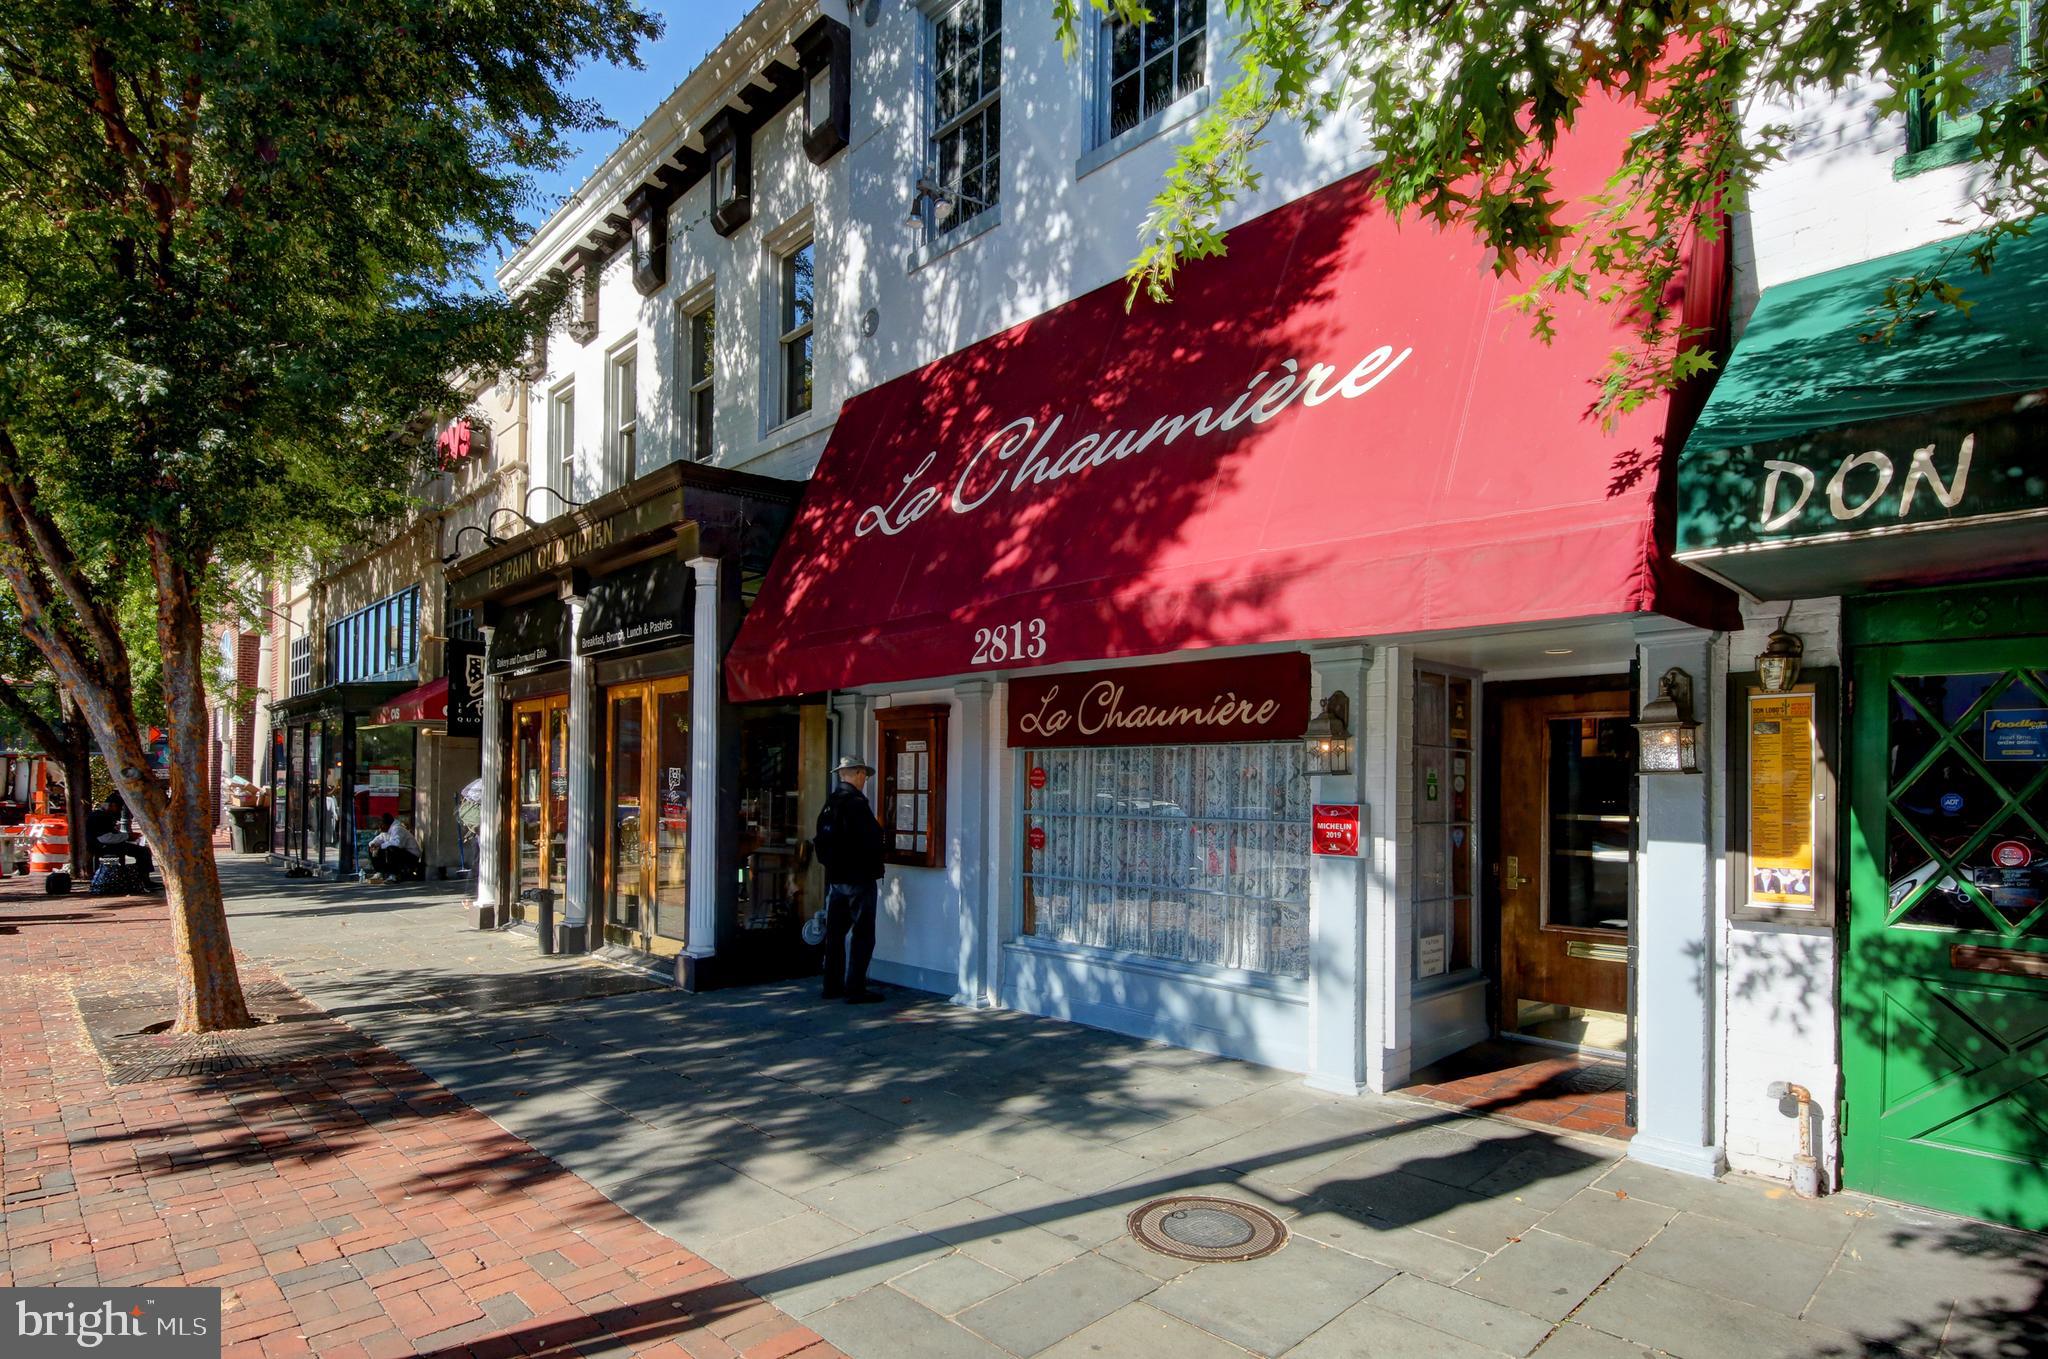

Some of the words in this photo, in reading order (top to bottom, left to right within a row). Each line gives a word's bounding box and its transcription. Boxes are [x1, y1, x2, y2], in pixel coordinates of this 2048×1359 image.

[854, 452, 941, 537] La
[951, 345, 1412, 514] Chaumière
[1761, 433, 1974, 531] DON
[488, 567, 501, 590] LE
[506, 551, 531, 583] PAIN
[537, 517, 613, 570] QUOTIDIEN
[582, 634, 605, 649] Breakfast,
[606, 629, 625, 642] Brunch,
[626, 624, 643, 639] Lunch
[643, 622, 649, 635] &
[649, 618, 673, 633] Pastries
[970, 617, 1046, 666] 2813
[1020, 685, 1072, 737] La
[1077, 680, 1281, 735] Chaumière
[1317, 822, 1352, 830] MICHELIN
[1943, 798, 1960, 806] ADT
[1326, 831, 1342, 839] 2019
